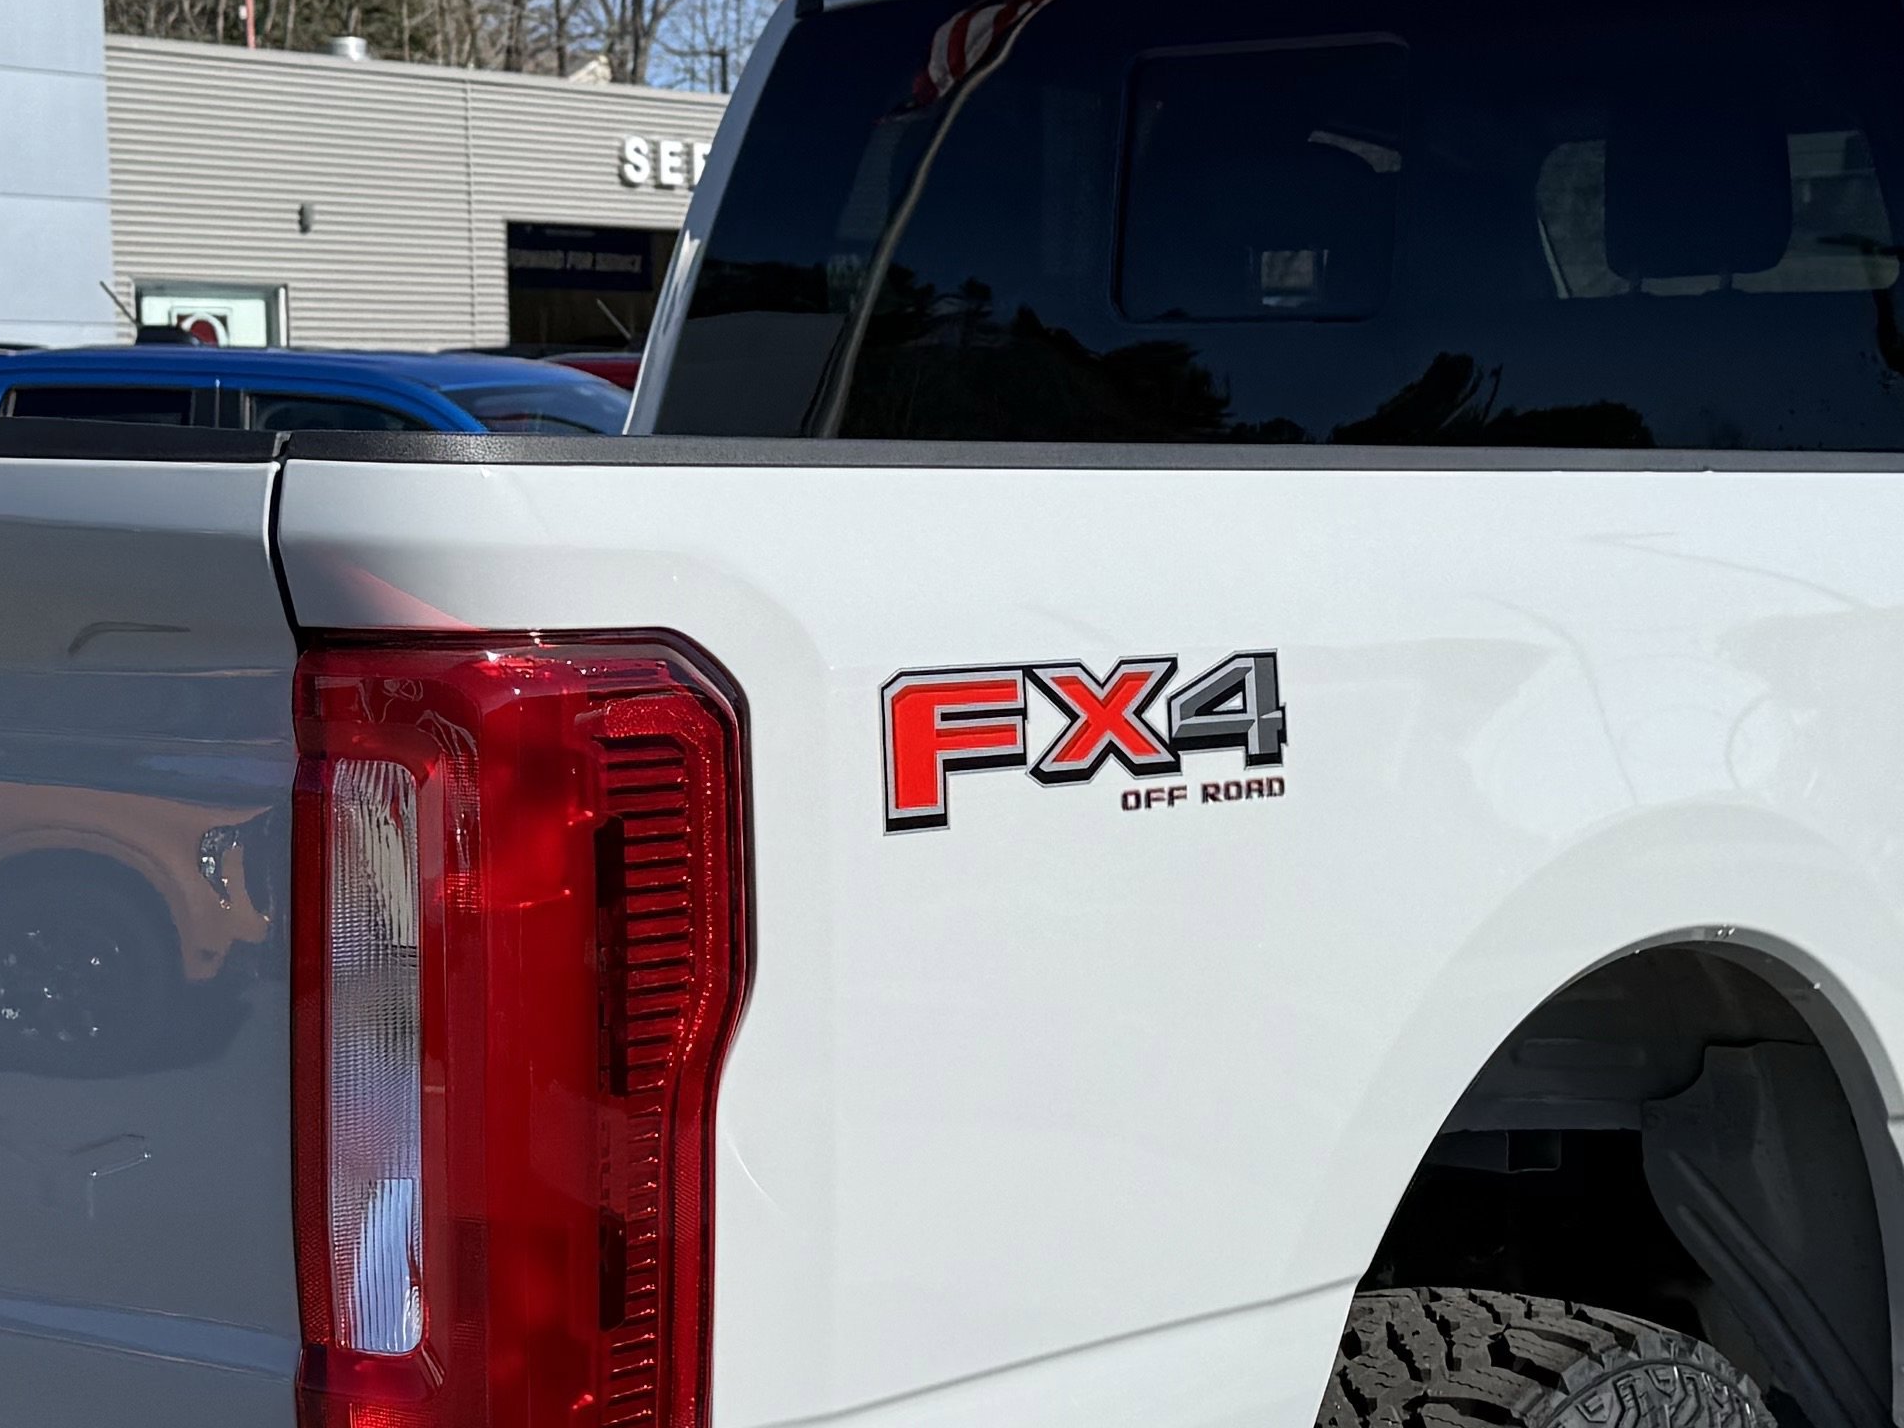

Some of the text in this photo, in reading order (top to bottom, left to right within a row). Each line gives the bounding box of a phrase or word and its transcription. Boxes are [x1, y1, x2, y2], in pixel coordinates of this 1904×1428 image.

[878, 648, 1287, 836] FX4
[1121, 777, 1286, 811] OFF ROAD
